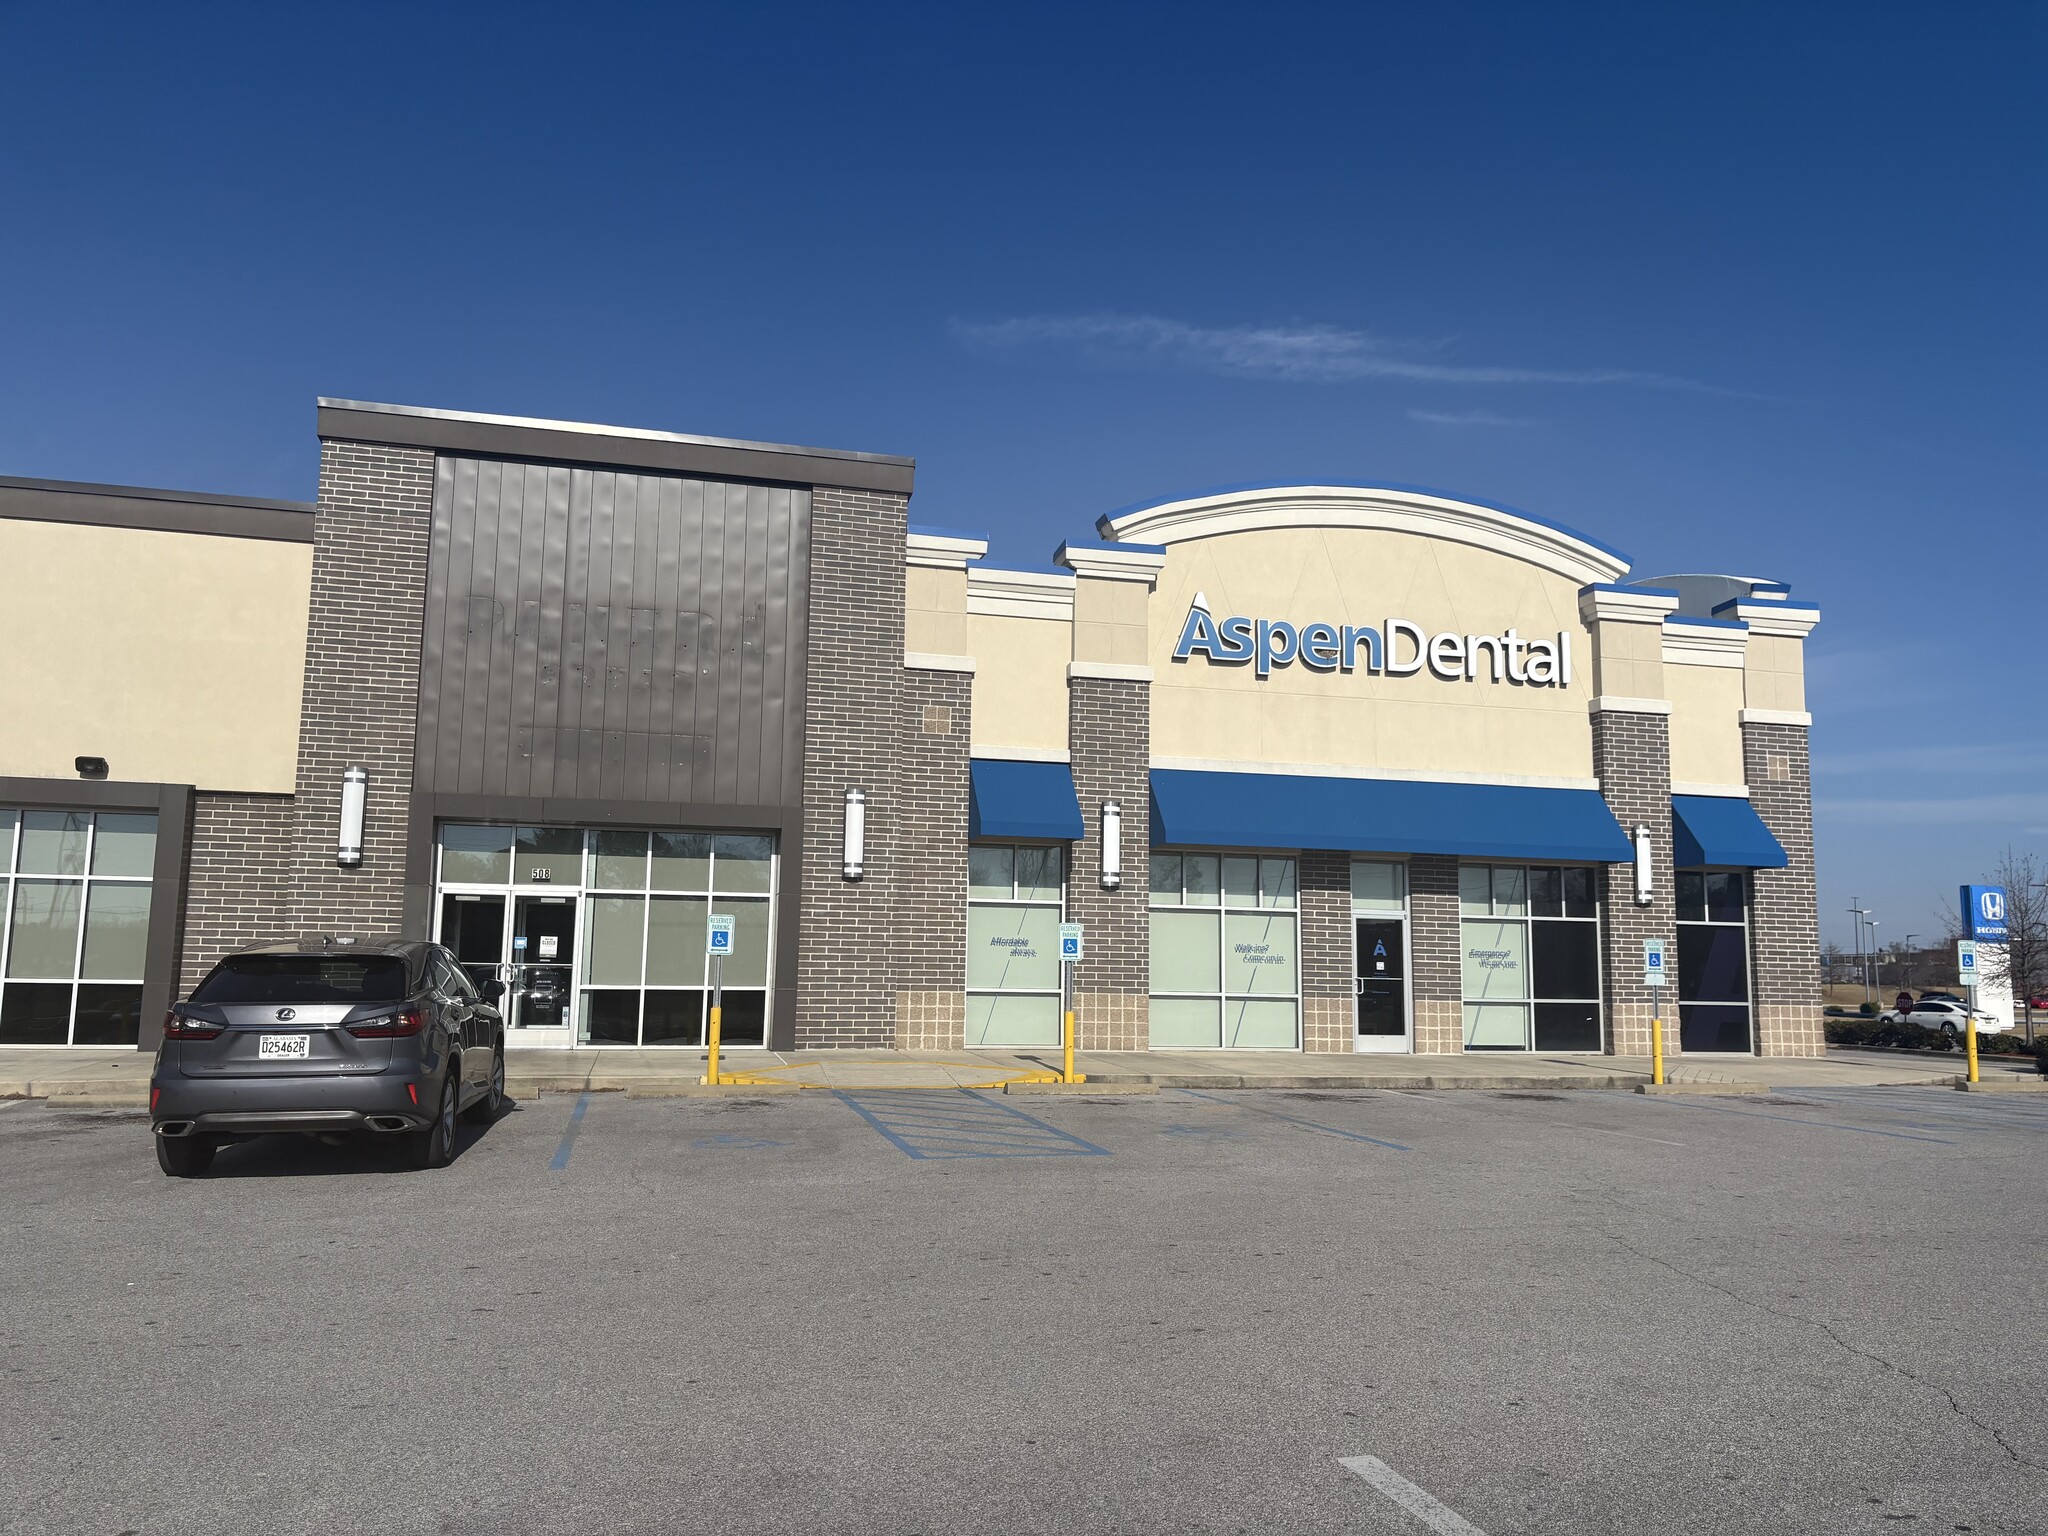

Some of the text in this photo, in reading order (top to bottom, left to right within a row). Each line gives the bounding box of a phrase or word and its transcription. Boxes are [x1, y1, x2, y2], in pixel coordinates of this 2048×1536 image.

[532, 869, 550, 878] 508
[989, 937, 1029, 948] Affordable
[1469, 949, 1511, 960] Emergency?
[1898, 999, 1912, 1008] STOP
[262, 1041, 305, 1053] D25462R
